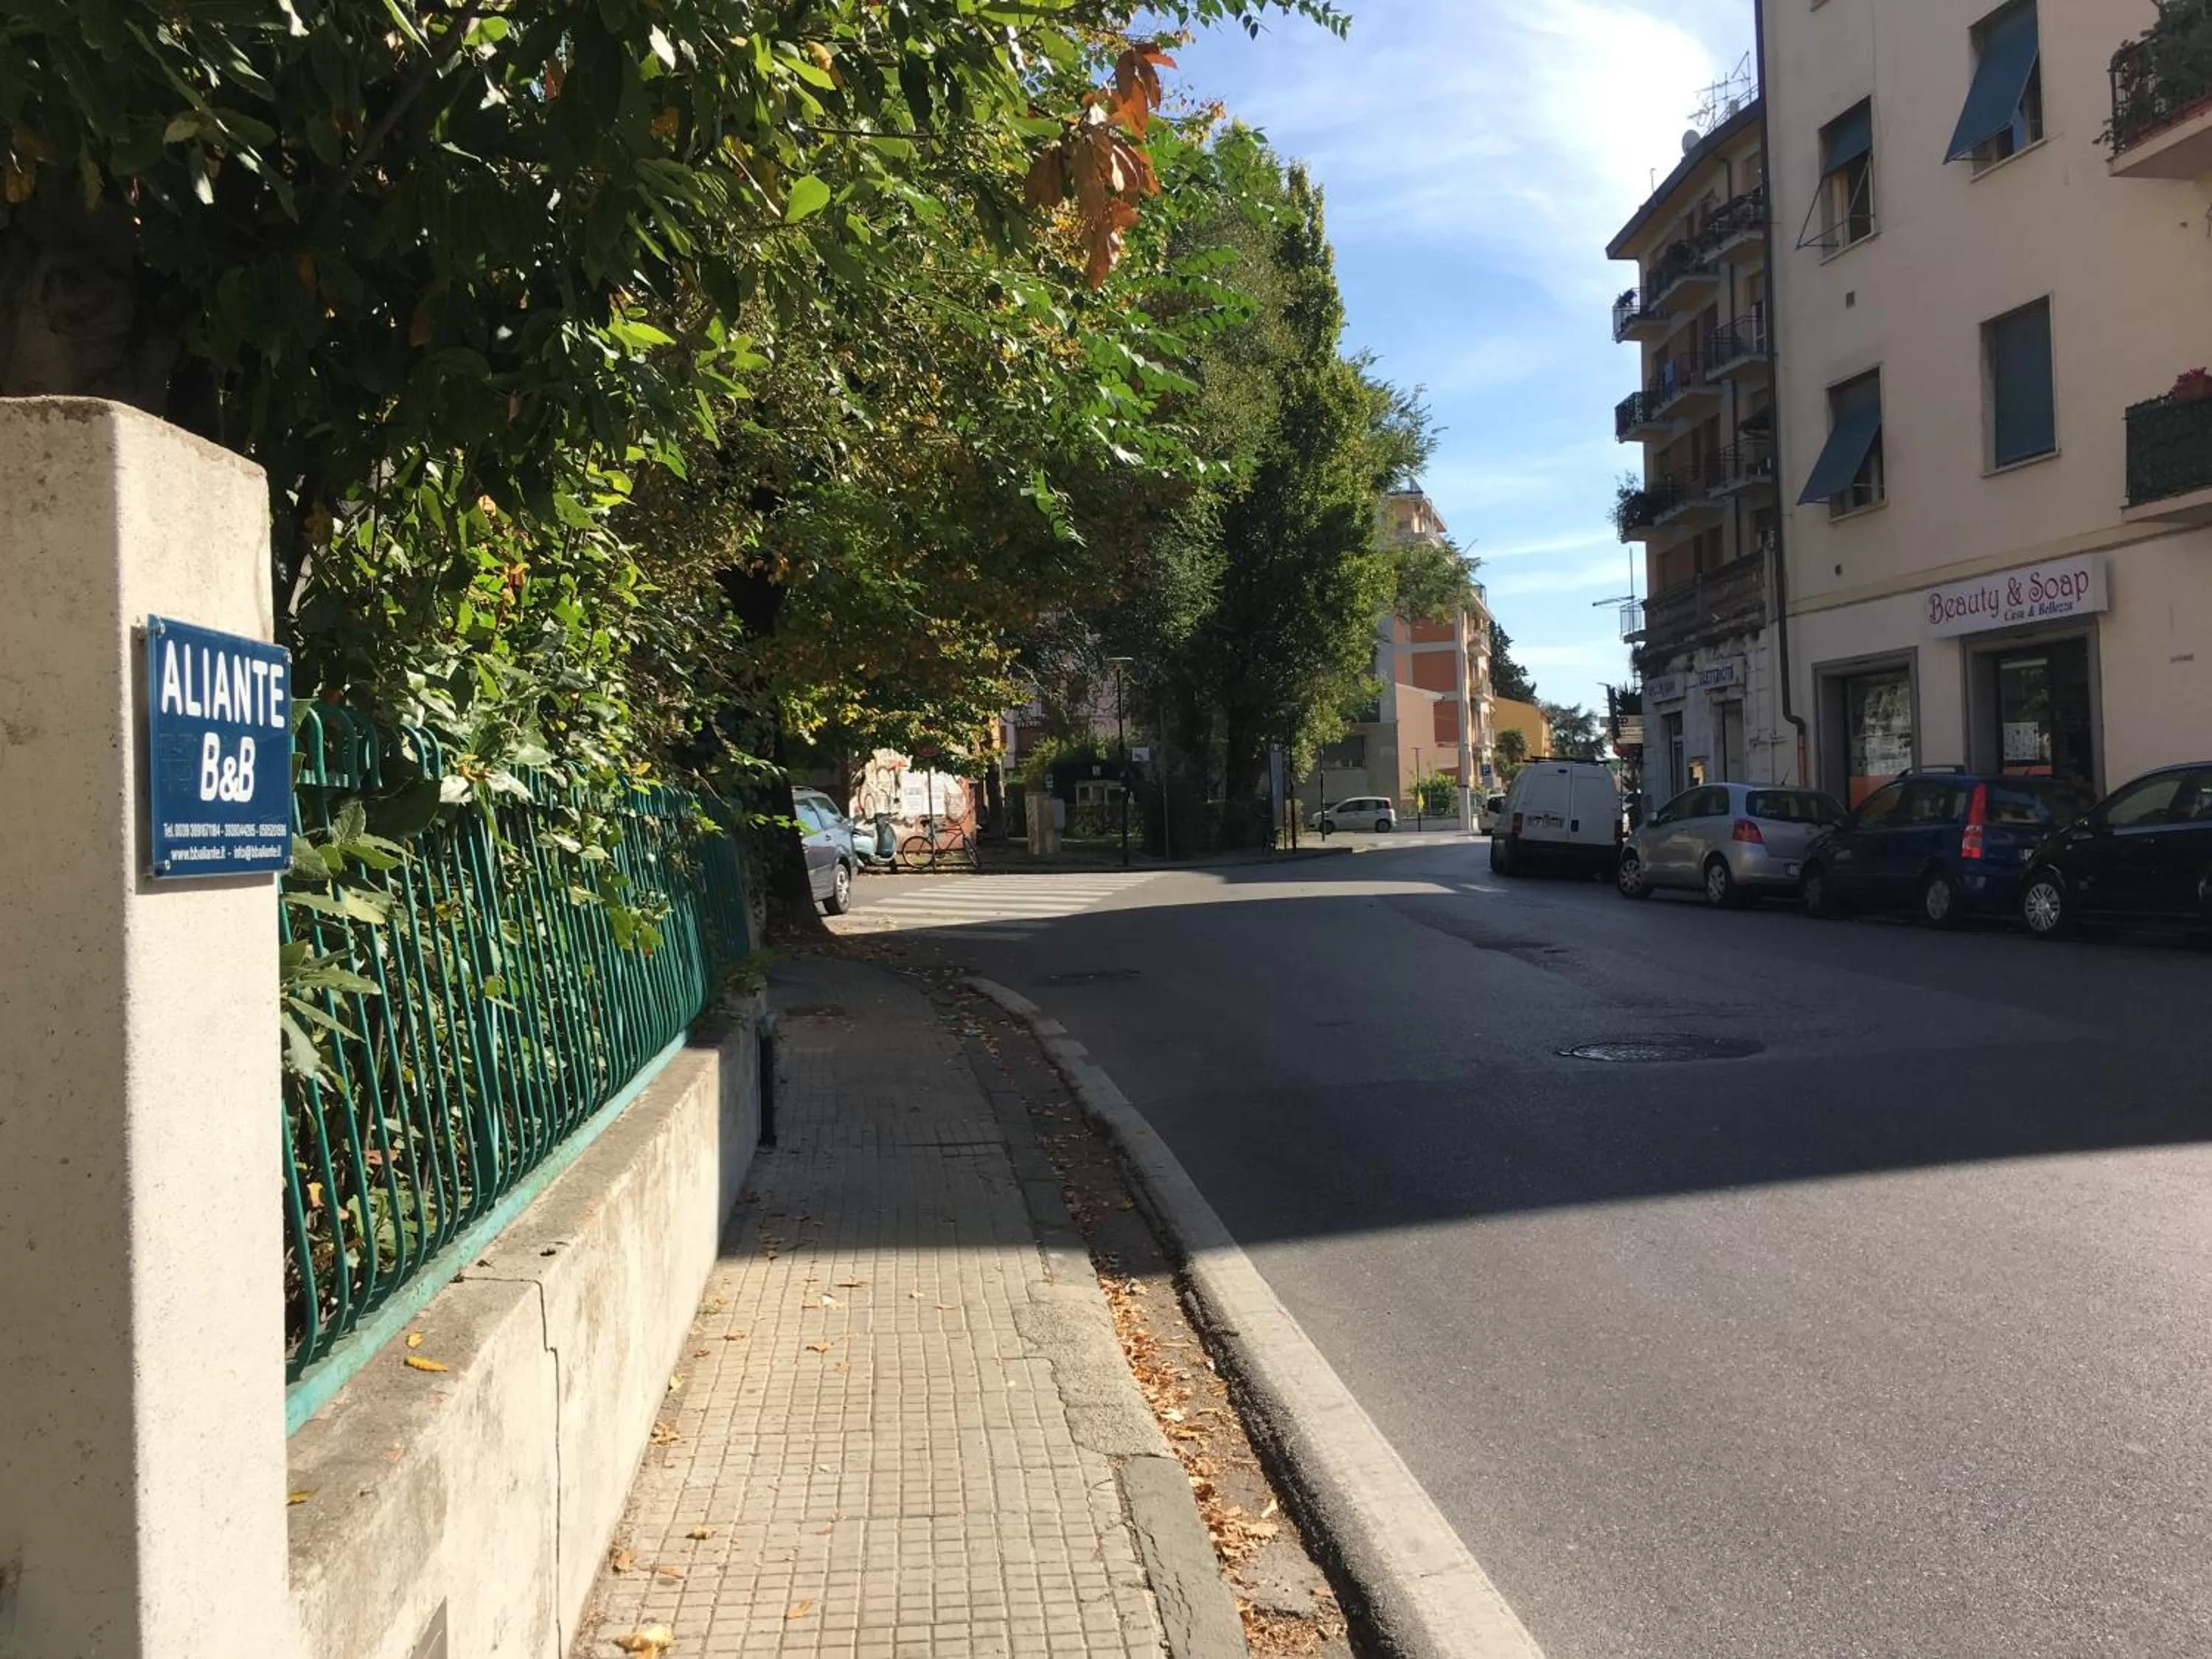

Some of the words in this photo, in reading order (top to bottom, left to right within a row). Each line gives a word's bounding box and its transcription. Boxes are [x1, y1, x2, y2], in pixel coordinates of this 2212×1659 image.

[1928, 587, 2000, 625] Beauty
[2006, 577, 2023, 607] &
[2028, 571, 2089, 602] Soap
[161, 639, 285, 728] ALIANTE
[200, 732, 256, 802] B&B
